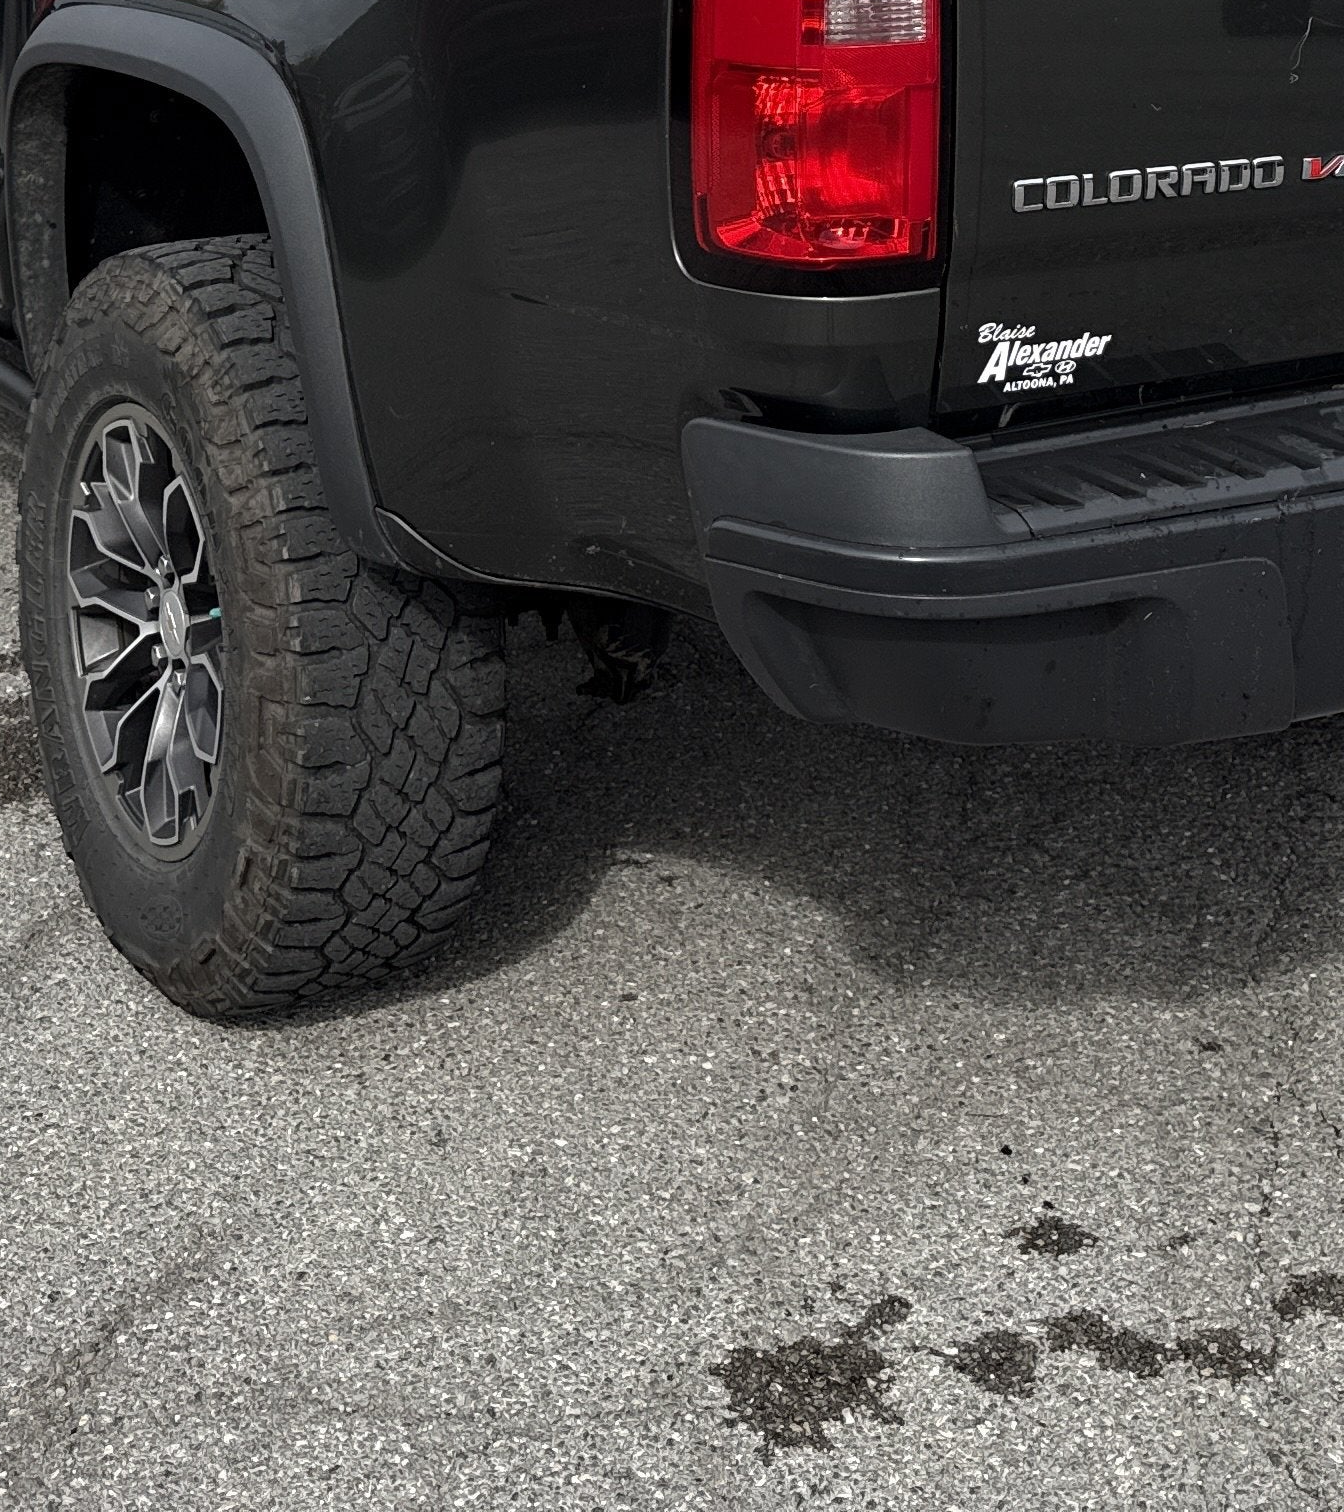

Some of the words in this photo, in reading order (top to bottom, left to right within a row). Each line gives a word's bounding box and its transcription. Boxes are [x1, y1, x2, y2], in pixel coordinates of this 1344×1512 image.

[1012, 155, 1285, 212] COLORADO
[977, 322, 1036, 344] Blaise
[976, 332, 1113, 384] Alexander
[1002, 376, 1057, 393] ALTOONA,
[1059, 373, 1075, 386] PA
